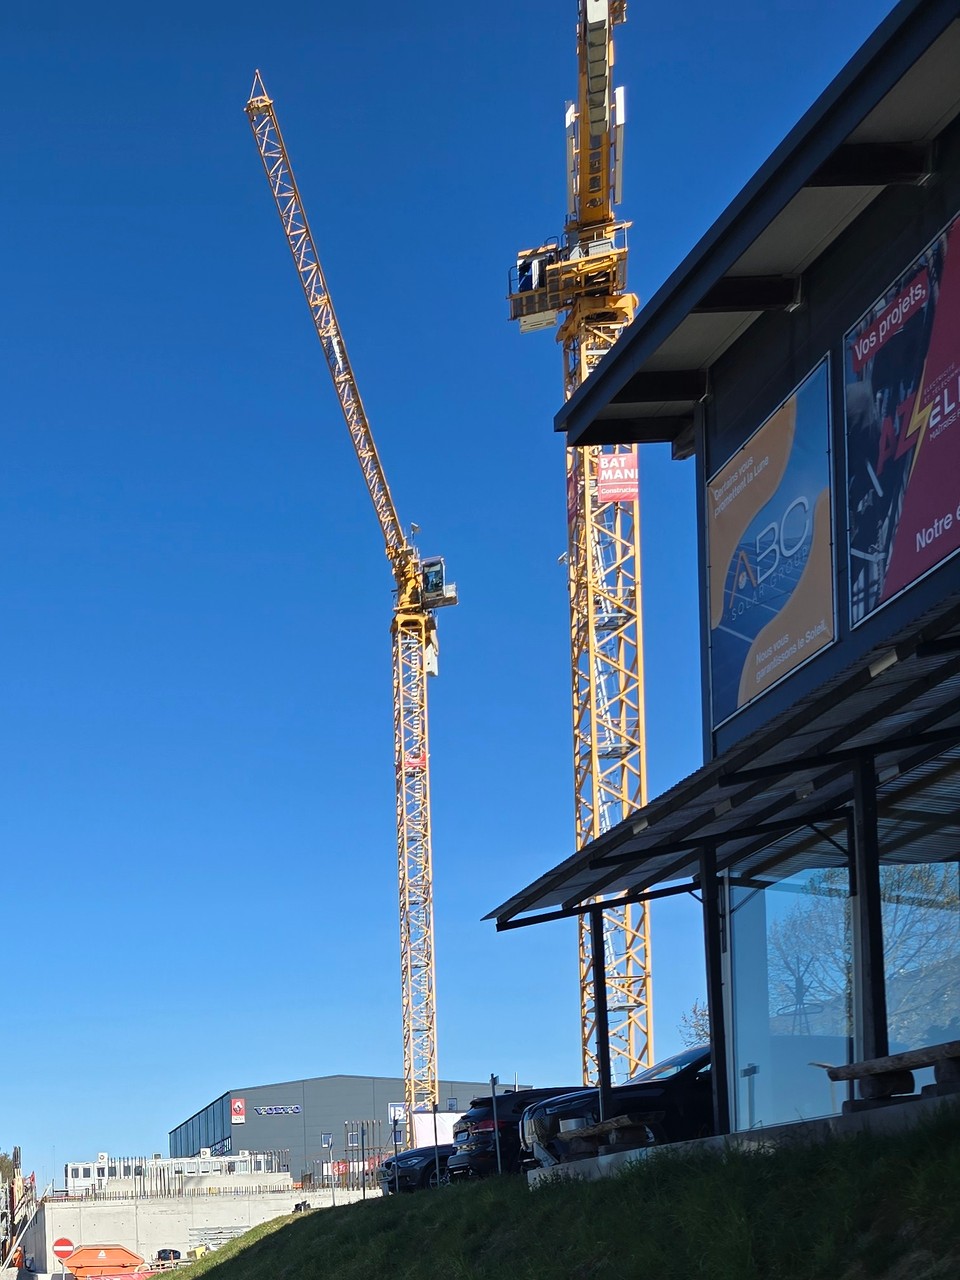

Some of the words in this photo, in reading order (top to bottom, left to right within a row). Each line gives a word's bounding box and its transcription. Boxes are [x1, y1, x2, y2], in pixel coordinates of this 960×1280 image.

[854, 331, 877, 361] Vos
[878, 282, 927, 343] projets,
[929, 376, 960, 429] ÉL
[600, 457, 627, 469] BAT
[738, 455, 754, 476] vous
[746, 472, 754, 484] la
[753, 455, 769, 477] Lune
[915, 513, 954, 553] Notre
[729, 495, 810, 609] ABC
[731, 584, 765, 621] SOLAR
[769, 544, 809, 588] GROUP
[755, 646, 773, 667] Nous
[772, 633, 790, 652] vous
[797, 637, 805, 650] le
[253, 1104, 302, 1116] VOLVO
